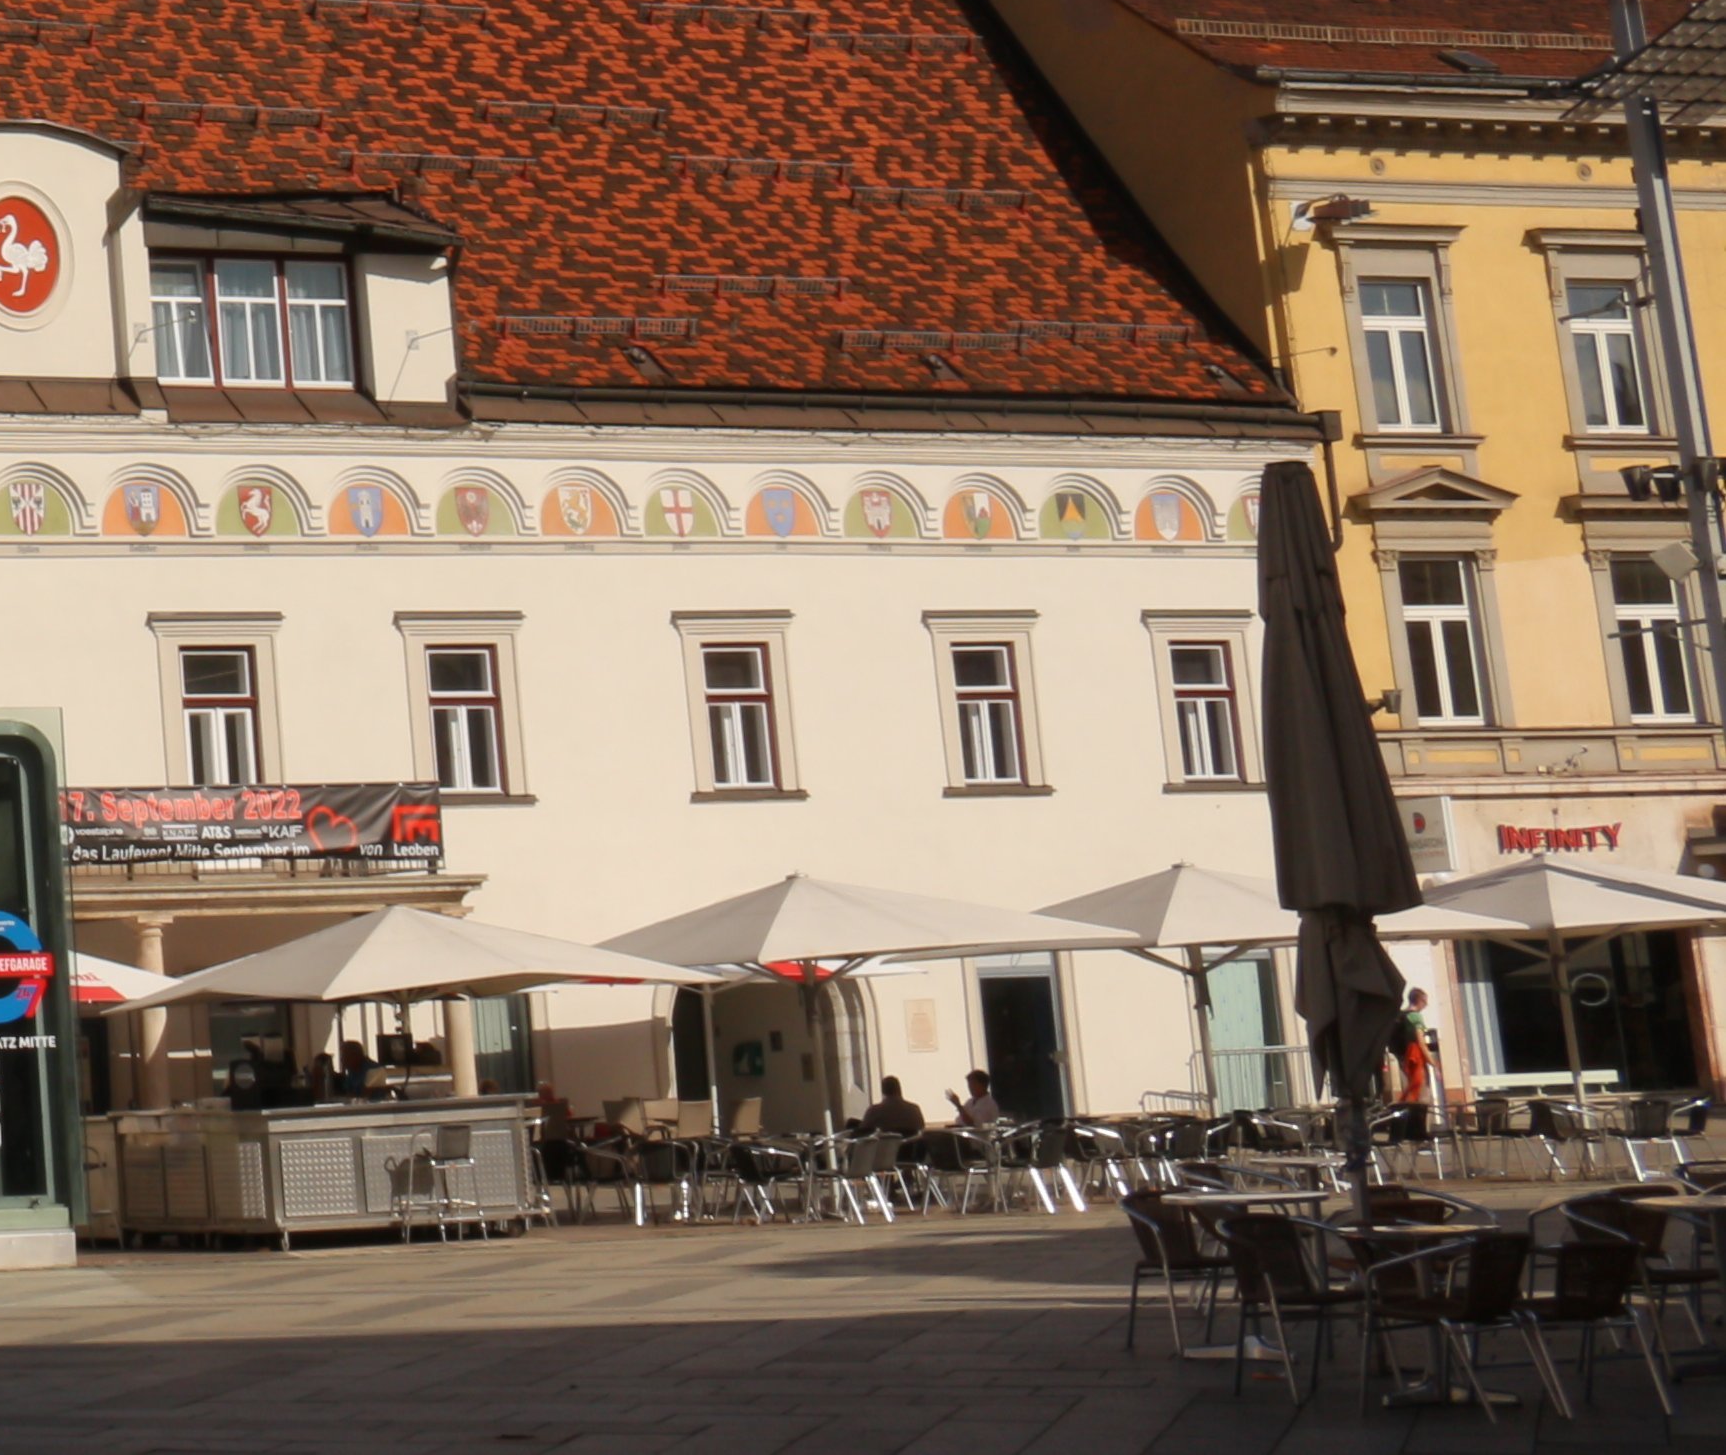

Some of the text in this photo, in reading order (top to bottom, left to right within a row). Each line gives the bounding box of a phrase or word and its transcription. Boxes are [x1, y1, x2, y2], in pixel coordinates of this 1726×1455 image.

[100, 789, 236, 828] September
[241, 788, 304, 821] 2022
[201, 825, 232, 839] AT&S
[1498, 822, 1623, 852] INFINITY
[72, 845, 98, 861] das
[102, 845, 172, 862] Laufevent
[175, 844, 210, 858] Mitte
[292, 842, 311, 855] im
[359, 845, 383, 857] von
[393, 844, 439, 857] Leoben
[19, 1035, 57, 1049] MITTE
